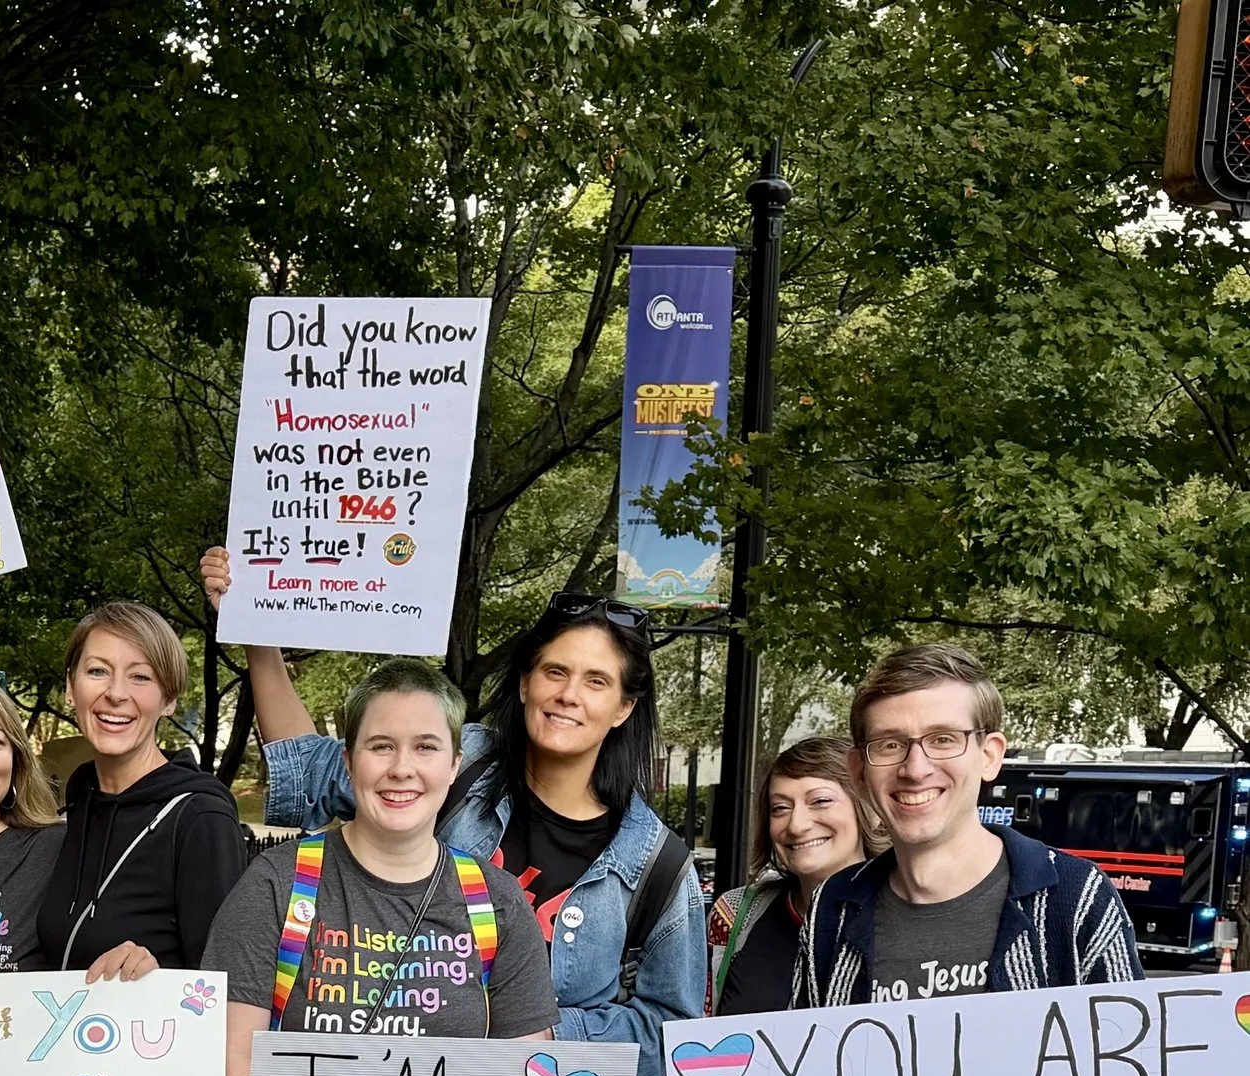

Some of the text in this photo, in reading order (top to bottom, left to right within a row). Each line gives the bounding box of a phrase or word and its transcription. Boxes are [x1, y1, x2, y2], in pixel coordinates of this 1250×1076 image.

[656, 312, 703, 322] ATLANTA
[267, 304, 478, 364] Did you know
[284, 348, 468, 390] that the word
[636, 384, 716, 398] ONE
[253, 438, 431, 466] was not even
[266, 468, 429, 494] in the Bible
[272, 497, 329, 520] until
[242, 528, 290, 556] It's
[383, 539, 416, 557] Pride
[268, 569, 387, 592] Learn more at
[315, 920, 349, 948] I'm
[312, 949, 475, 985] I'm Learning.
[917, 960, 989, 998] Jesus
[307, 977, 448, 1014] I'm Loving.
[303, 1006, 426, 1037] I'm Sorry.
